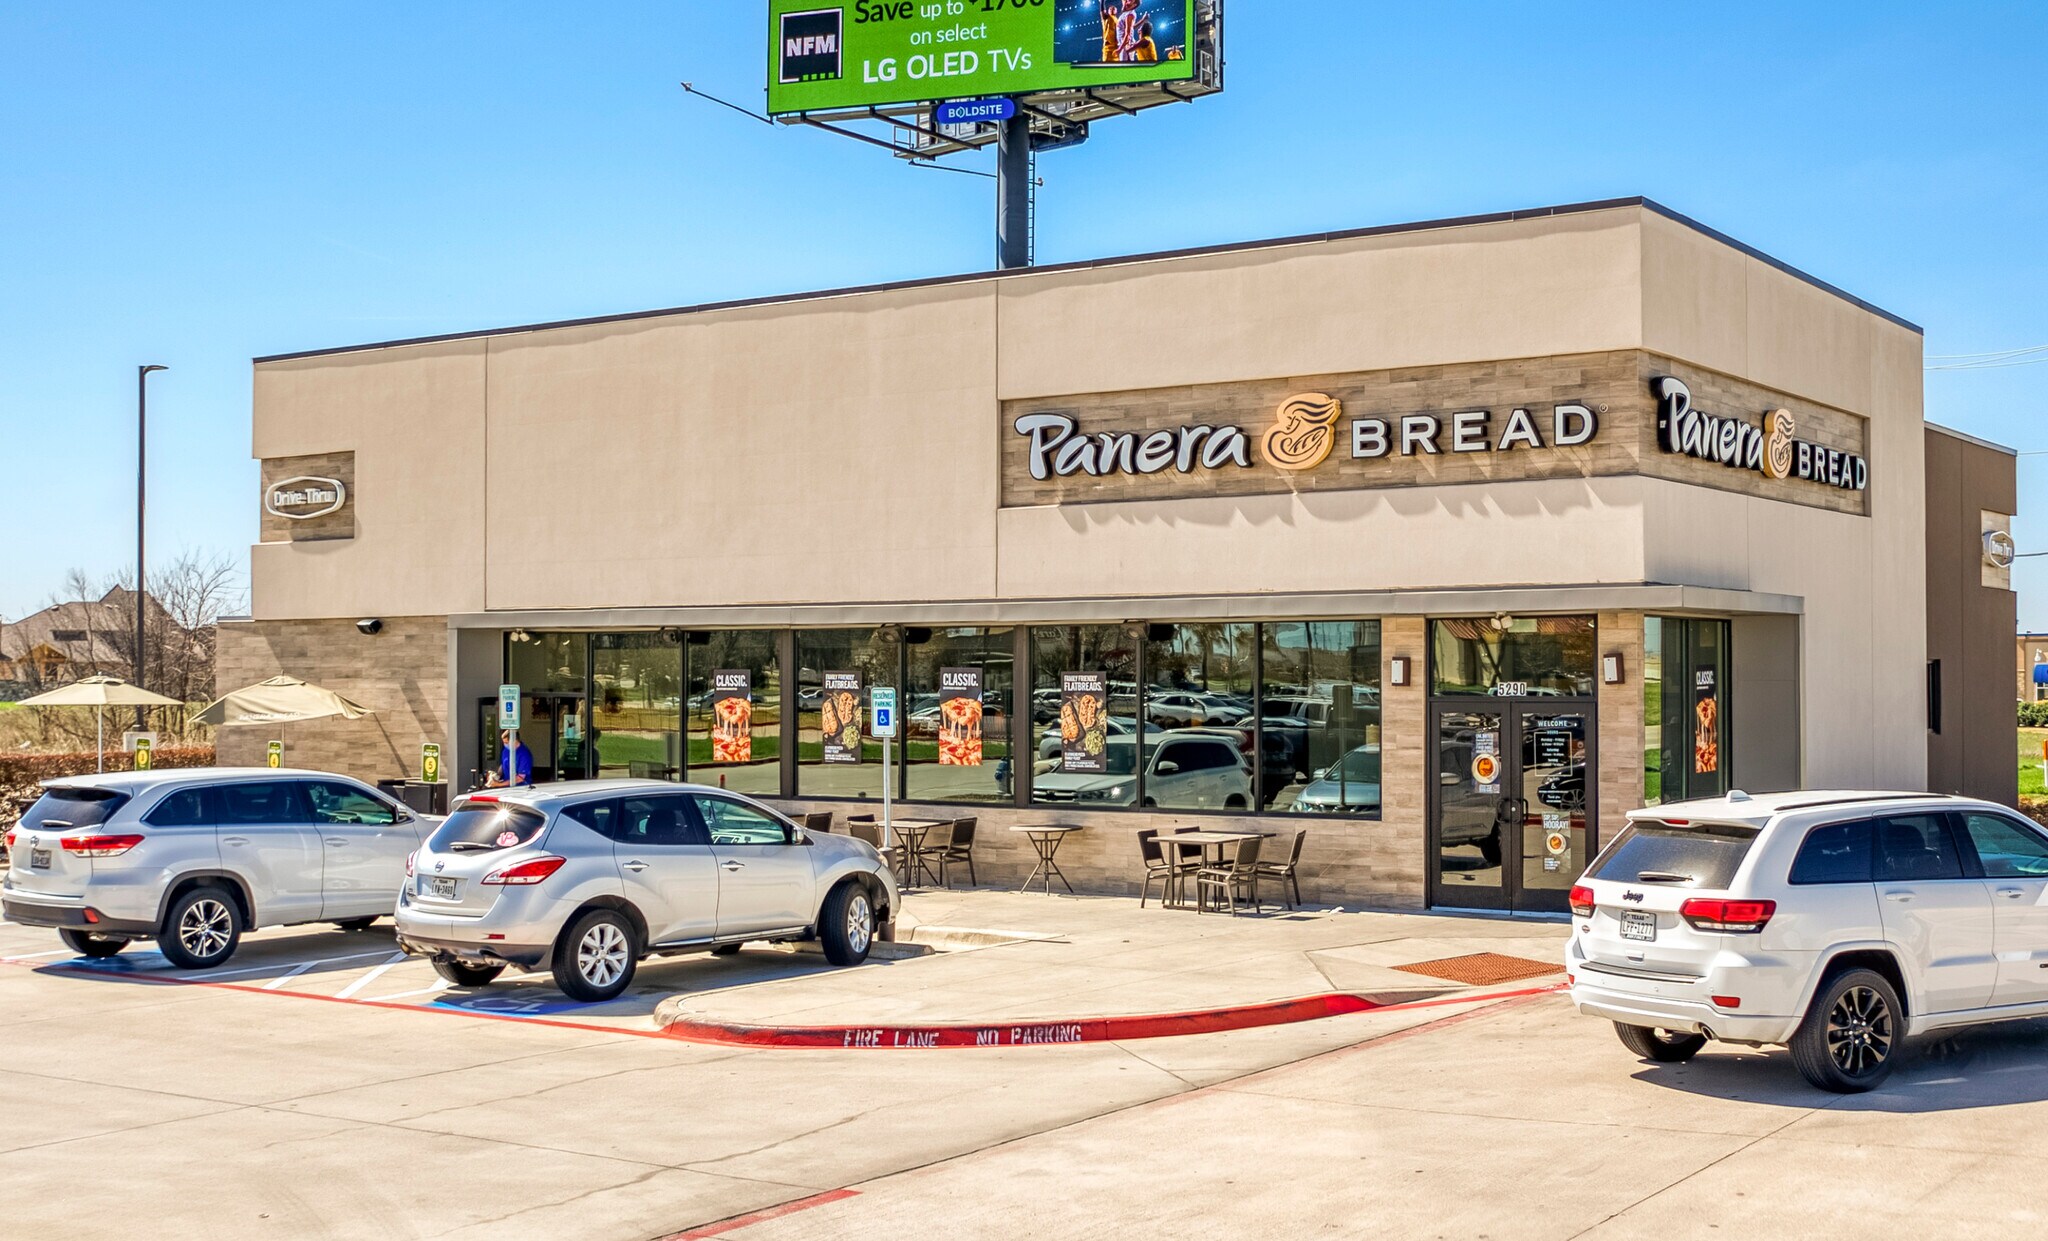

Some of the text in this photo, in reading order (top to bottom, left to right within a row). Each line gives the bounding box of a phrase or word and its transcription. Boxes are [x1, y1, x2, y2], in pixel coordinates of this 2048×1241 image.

[855, 0, 914, 24] Save
[921, 3, 942, 20] up
[946, 1, 964, 15] to
[910, 23, 987, 45] on select
[863, 47, 1032, 84] LG OLED TVs
[948, 105, 1003, 118] BOLDSITE
[1014, 404, 1598, 480] Panera BREAD
[1656, 376, 1867, 490] Panera BREAD
[716, 674, 747, 687] CLASSIC.
[942, 673, 979, 687] CLASSIC.
[1499, 683, 1525, 695] 5290
[1622, 889, 1644, 903] Jeep
[843, 1024, 1082, 1048] FIRE LANE NO PARKING
